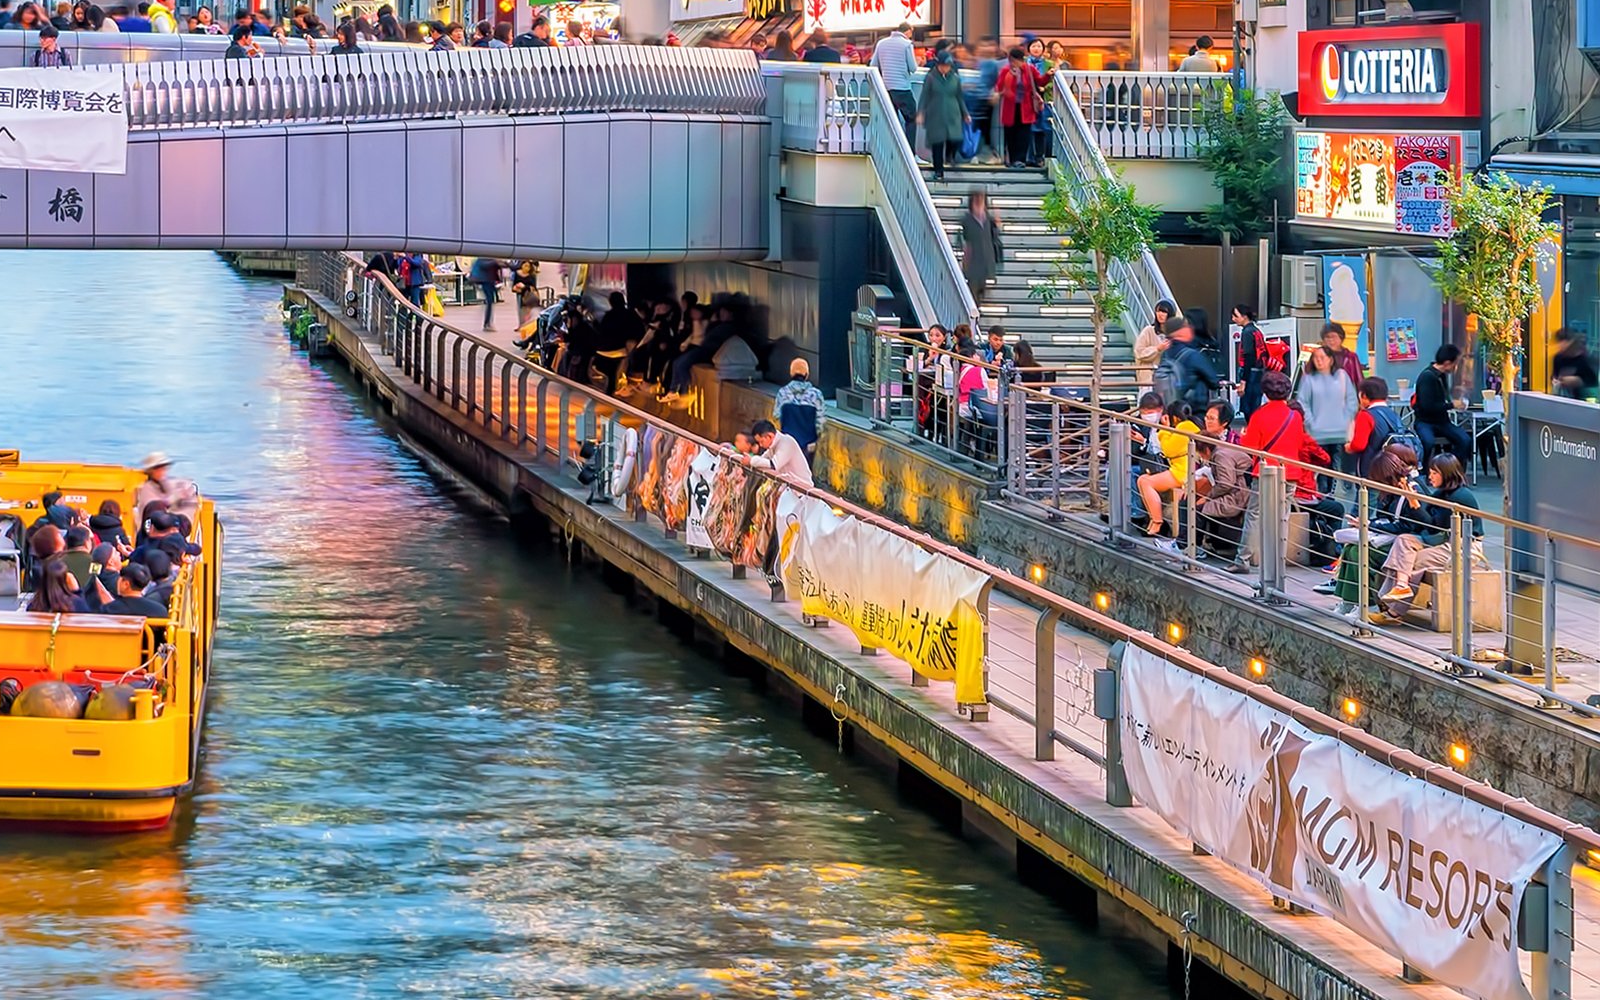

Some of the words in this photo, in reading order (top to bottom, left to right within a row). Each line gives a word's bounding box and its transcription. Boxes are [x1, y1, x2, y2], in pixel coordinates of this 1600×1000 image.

[1343, 47, 1438, 94] LOTTERIA
[1397, 148, 1449, 160] たこやき
[1401, 200, 1442, 209] KOREAN
[1413, 224, 1431, 232] ICE
[1553, 431, 1597, 461] information
[1296, 786, 1379, 880] MGM
[1305, 857, 1348, 915] JAPAN
